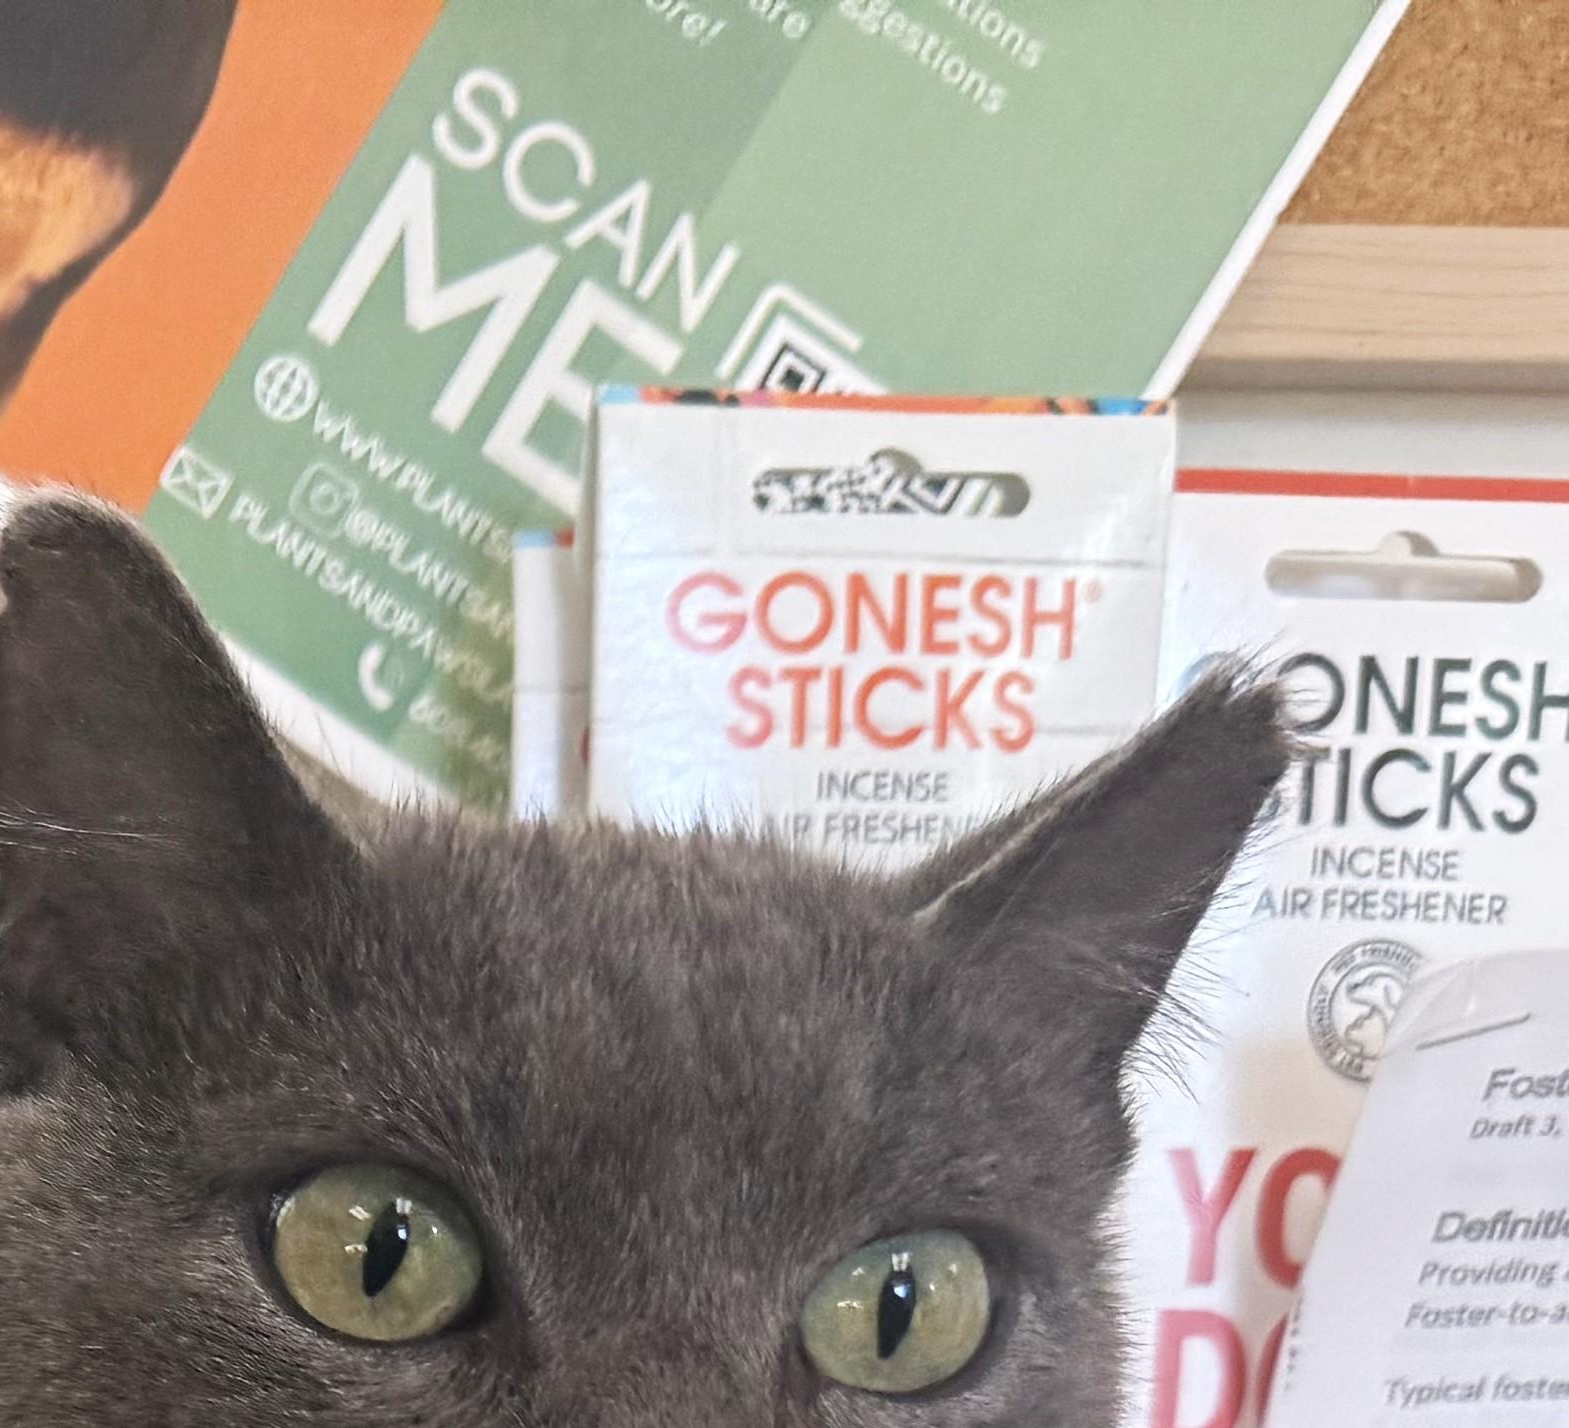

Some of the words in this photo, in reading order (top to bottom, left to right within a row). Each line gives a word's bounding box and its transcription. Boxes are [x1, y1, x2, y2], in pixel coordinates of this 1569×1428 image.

[432, 67, 741, 333] SCAN
[306, 153, 683, 515] ME
[666, 570, 1078, 660] GONESH
[726, 665, 1036, 753] STICKS
[1174, 650, 1569, 743] ONESH
[817, 770, 949, 802] INCENSE
[1311, 845, 1461, 881] INCENSE
[1251, 886, 1311, 918] AIR
[1320, 887, 1509, 926] FRESHENER
[1469, 1114, 1534, 1140] Draft
[1419, 1258, 1559, 1288] Providing
[1405, 1298, 1569, 1329] Foster-to-a
[1383, 1374, 1487, 1409] Typical
